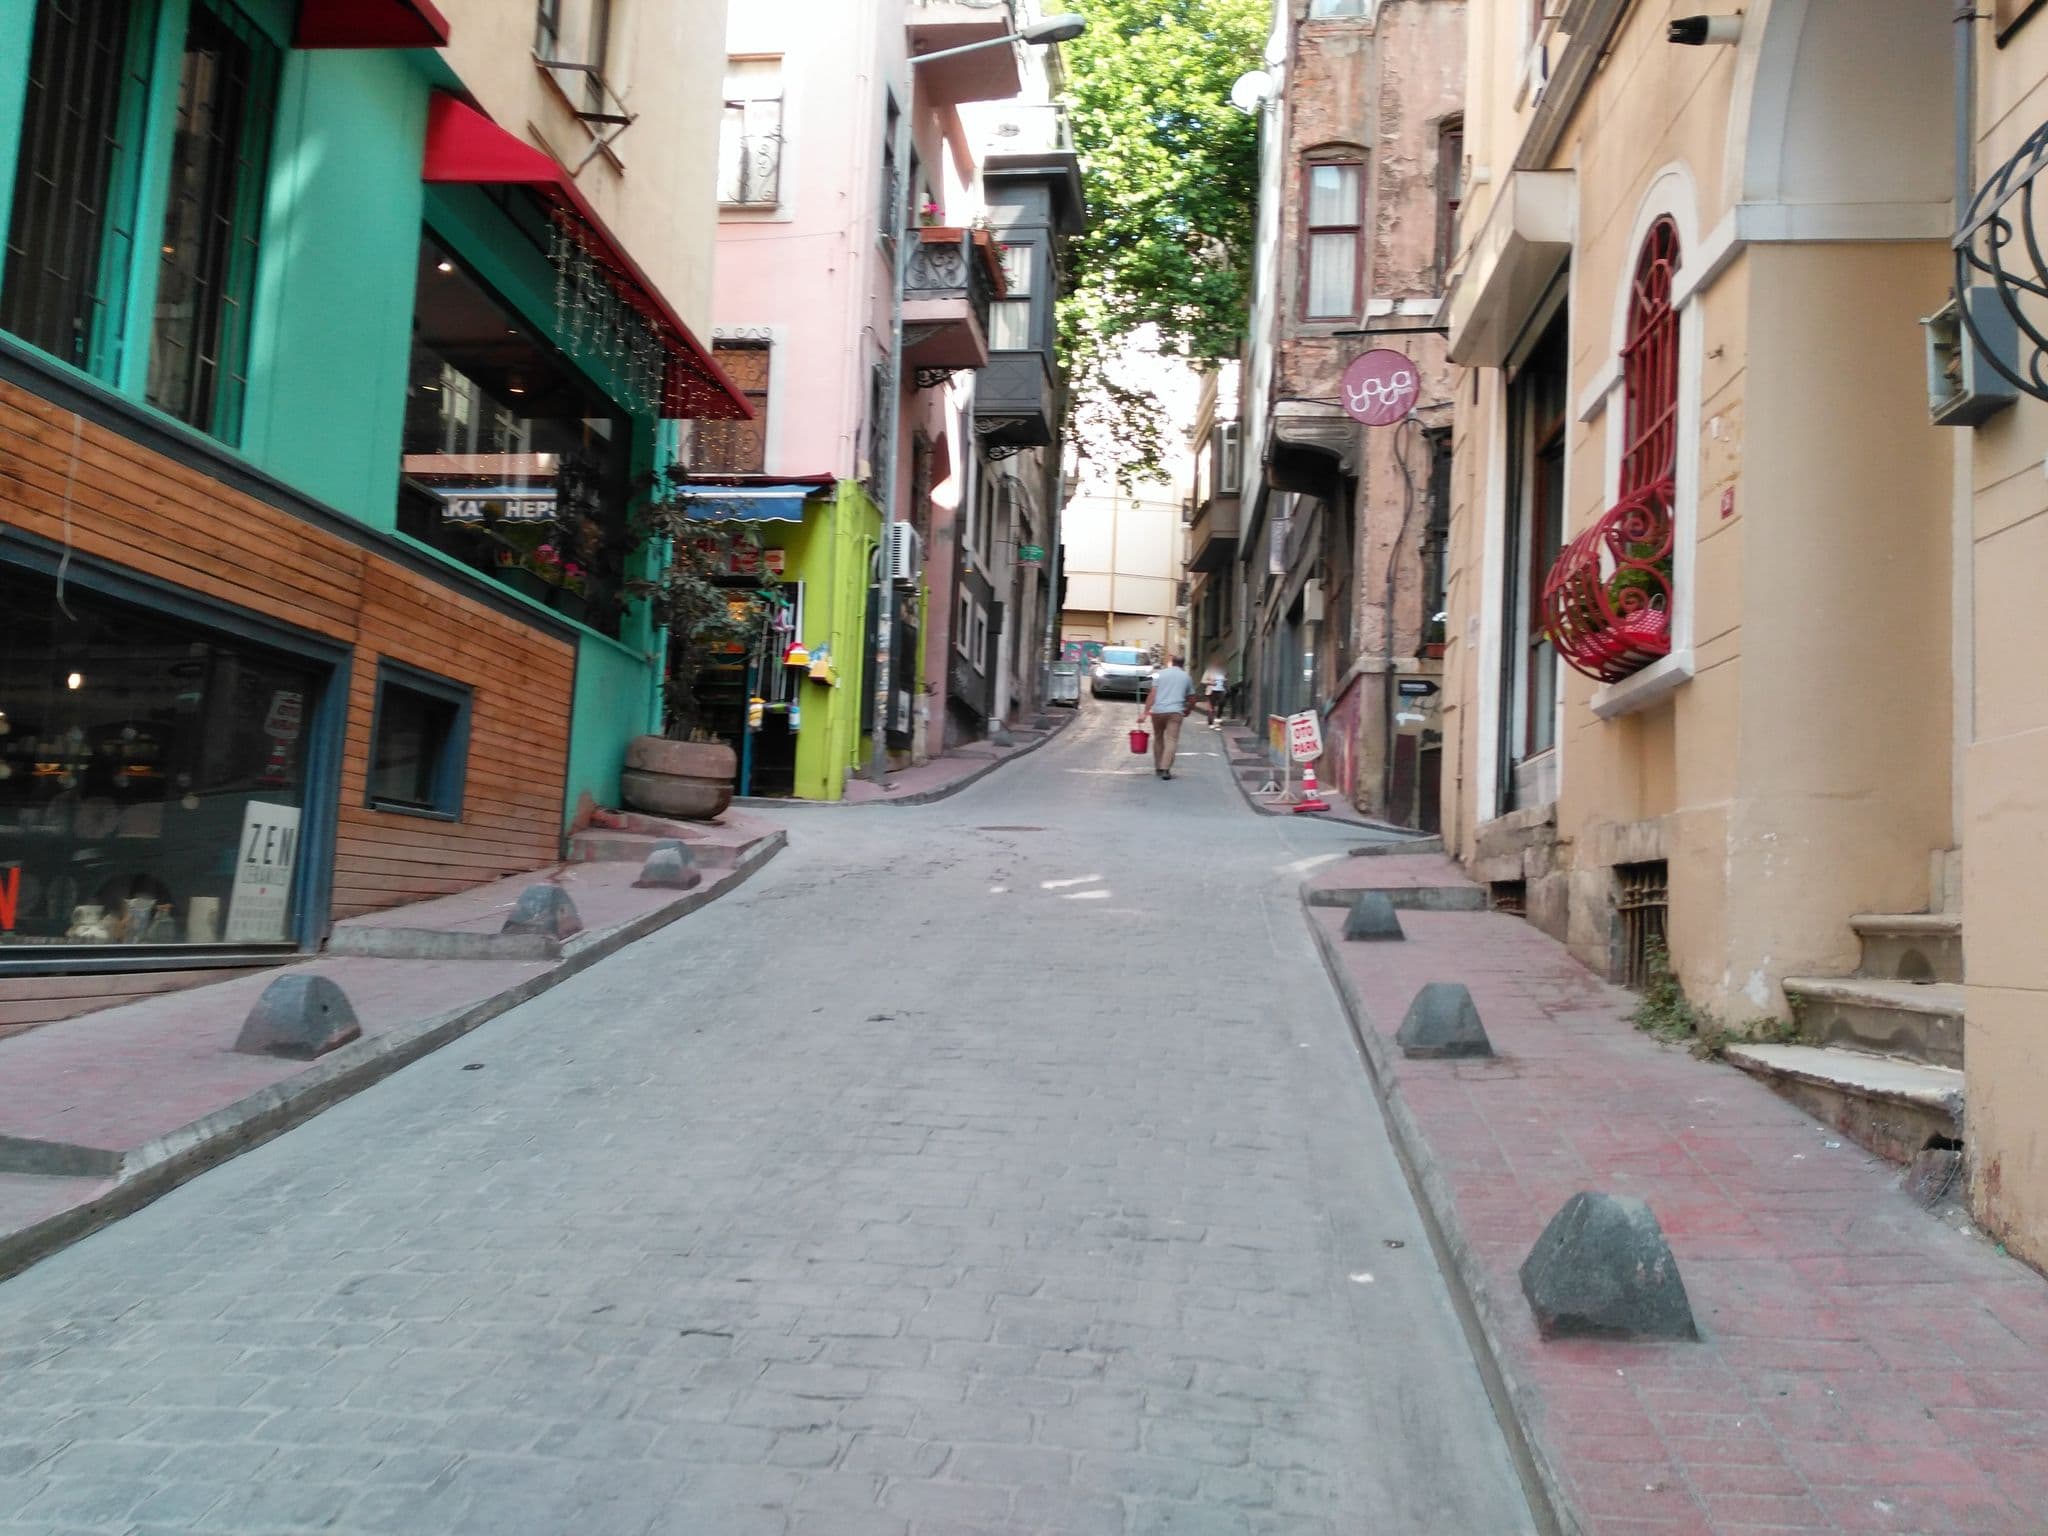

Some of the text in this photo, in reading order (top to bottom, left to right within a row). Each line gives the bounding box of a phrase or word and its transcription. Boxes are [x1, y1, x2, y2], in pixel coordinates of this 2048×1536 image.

[1346, 371, 1411, 412] yaya
[1294, 726, 1313, 739] OTO
[1294, 740, 1319, 753] PARK
[247, 824, 294, 866] ZEN
